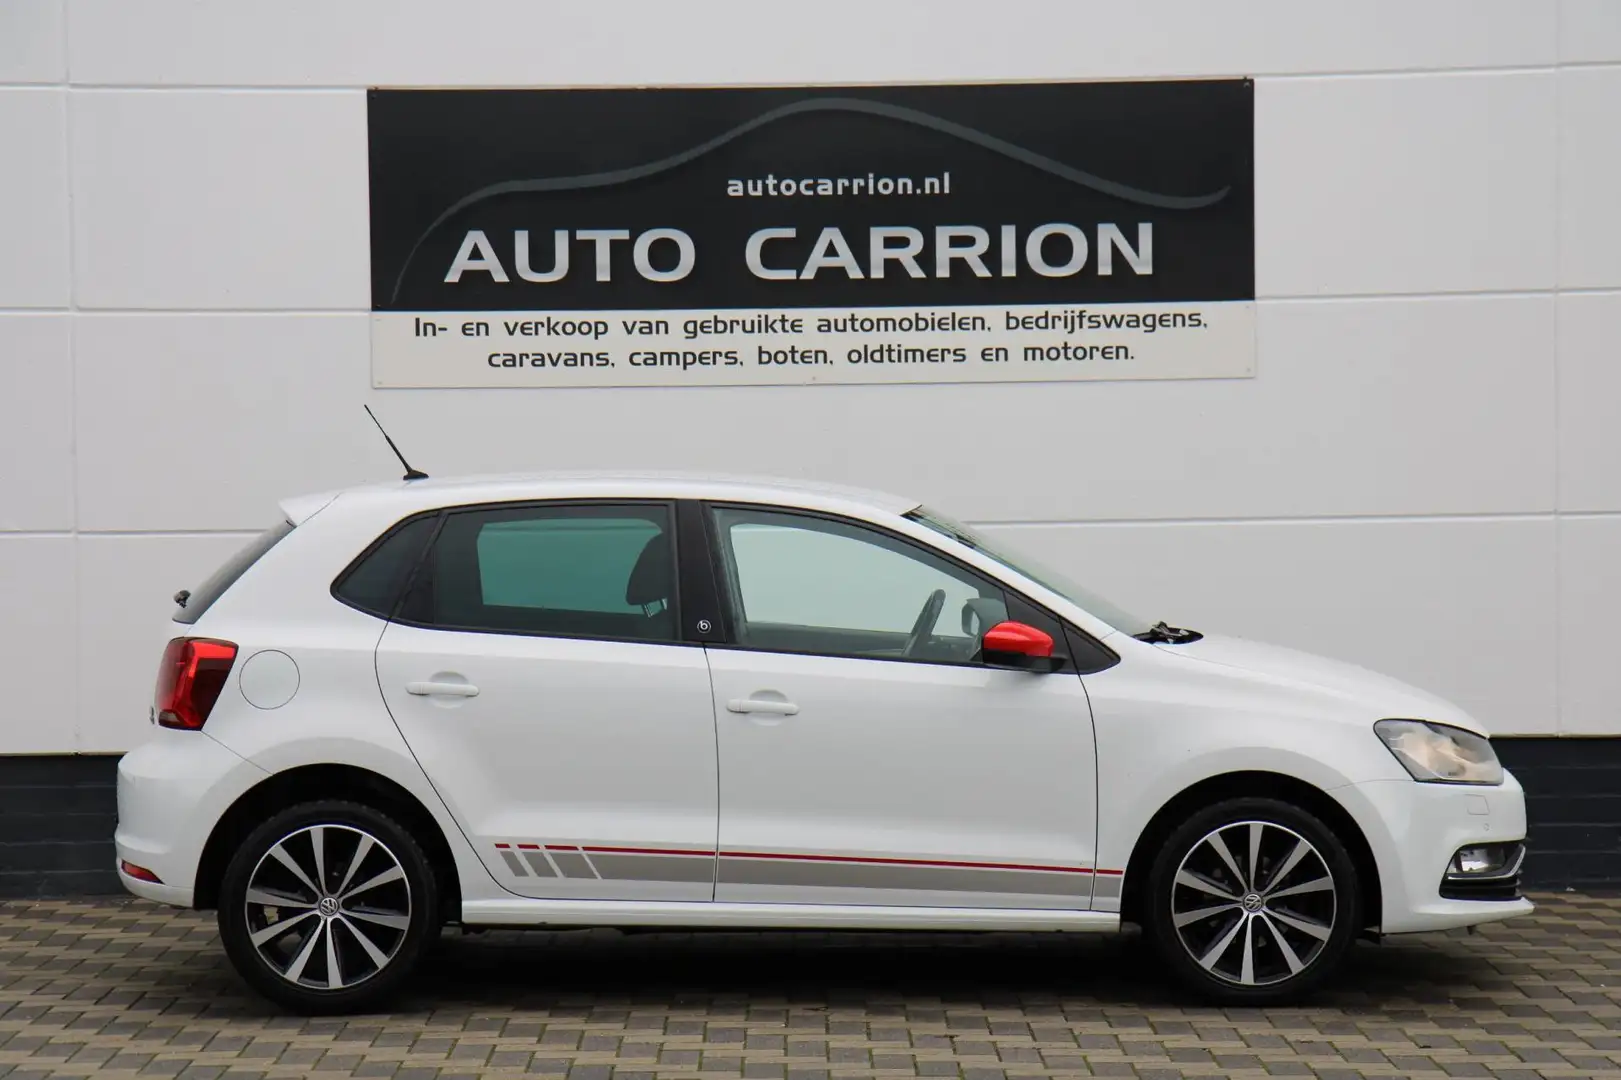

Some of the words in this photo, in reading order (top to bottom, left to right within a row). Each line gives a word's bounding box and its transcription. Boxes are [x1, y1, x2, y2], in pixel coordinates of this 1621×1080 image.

[726, 172, 950, 197] autocarrion.nl
[443, 228, 696, 284] AUTO
[745, 222, 1154, 282] CARRION
[414, 317, 448, 337] In-
[461, 321, 490, 337] en
[503, 316, 609, 341] verkoop
[622, 320, 669, 335] van
[683, 314, 803, 340] gebruikte
[847, 343, 967, 364] oldtimers
[980, 347, 1009, 363] en
[1023, 341, 1135, 362] motoren.
